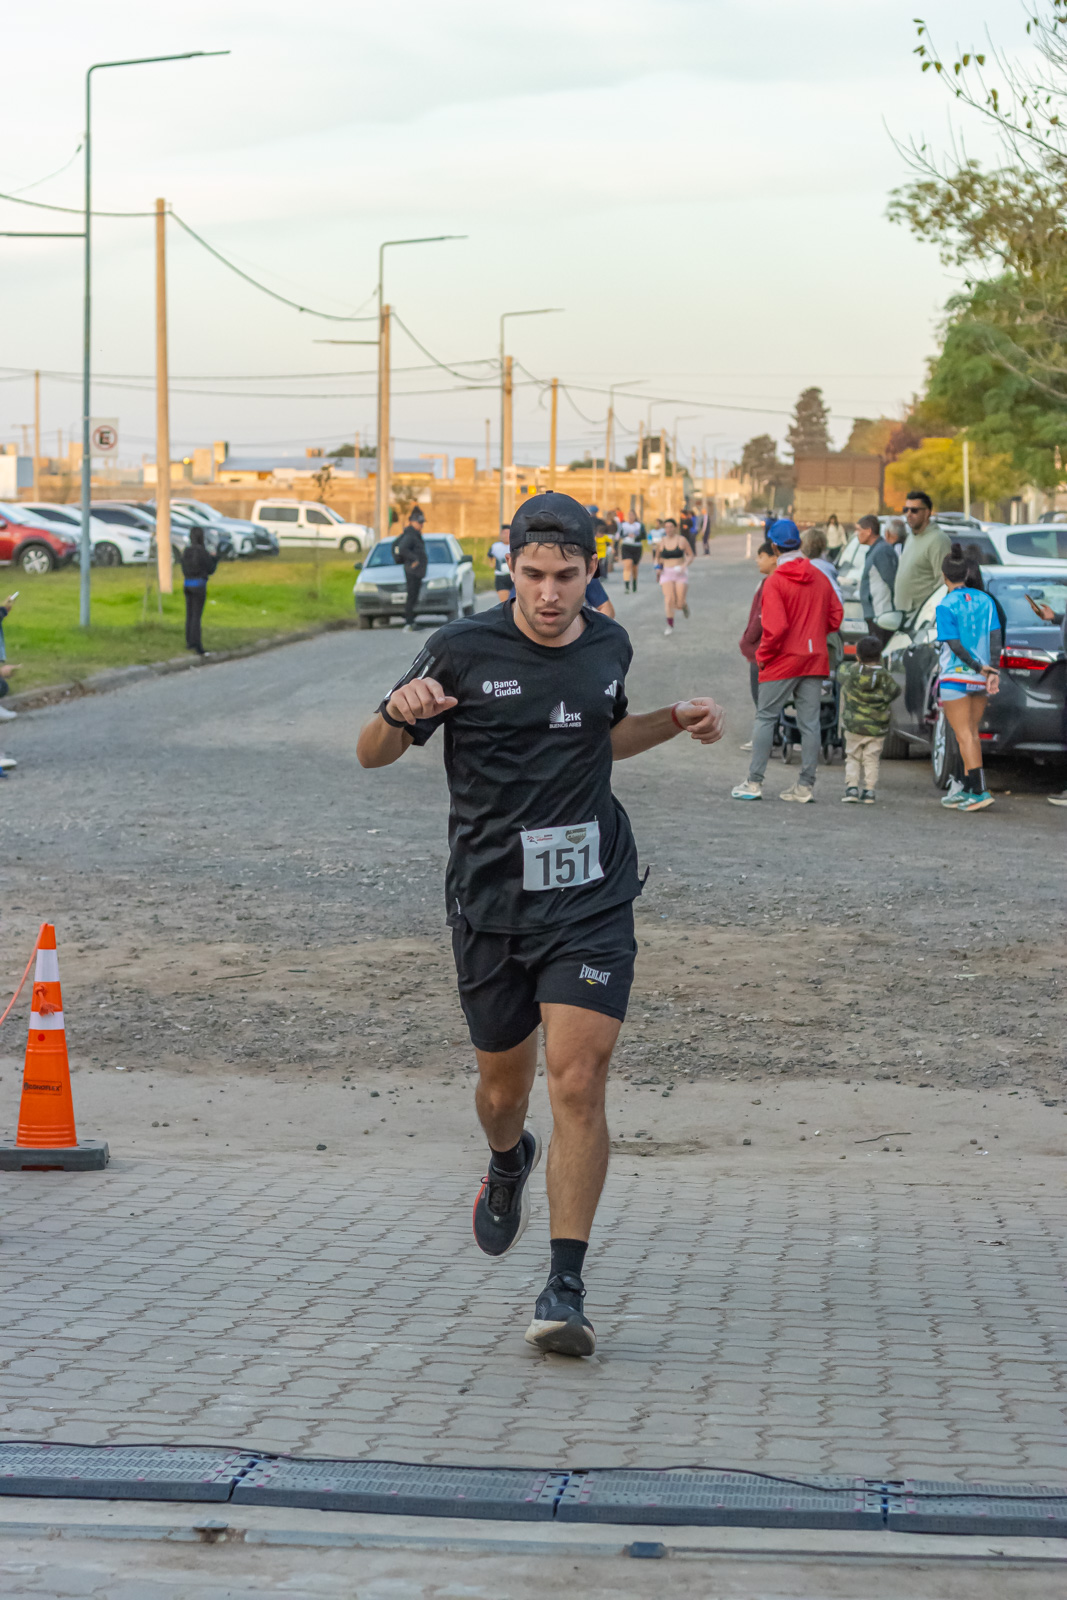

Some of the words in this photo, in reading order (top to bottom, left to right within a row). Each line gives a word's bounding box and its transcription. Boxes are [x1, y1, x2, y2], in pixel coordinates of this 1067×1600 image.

[494, 680, 518, 688] Banco
[494, 687, 521, 697] Ciudad
[565, 713, 581, 722] 21K
[535, 845, 591, 886] 151
[579, 964, 611, 986] EVERLAST
